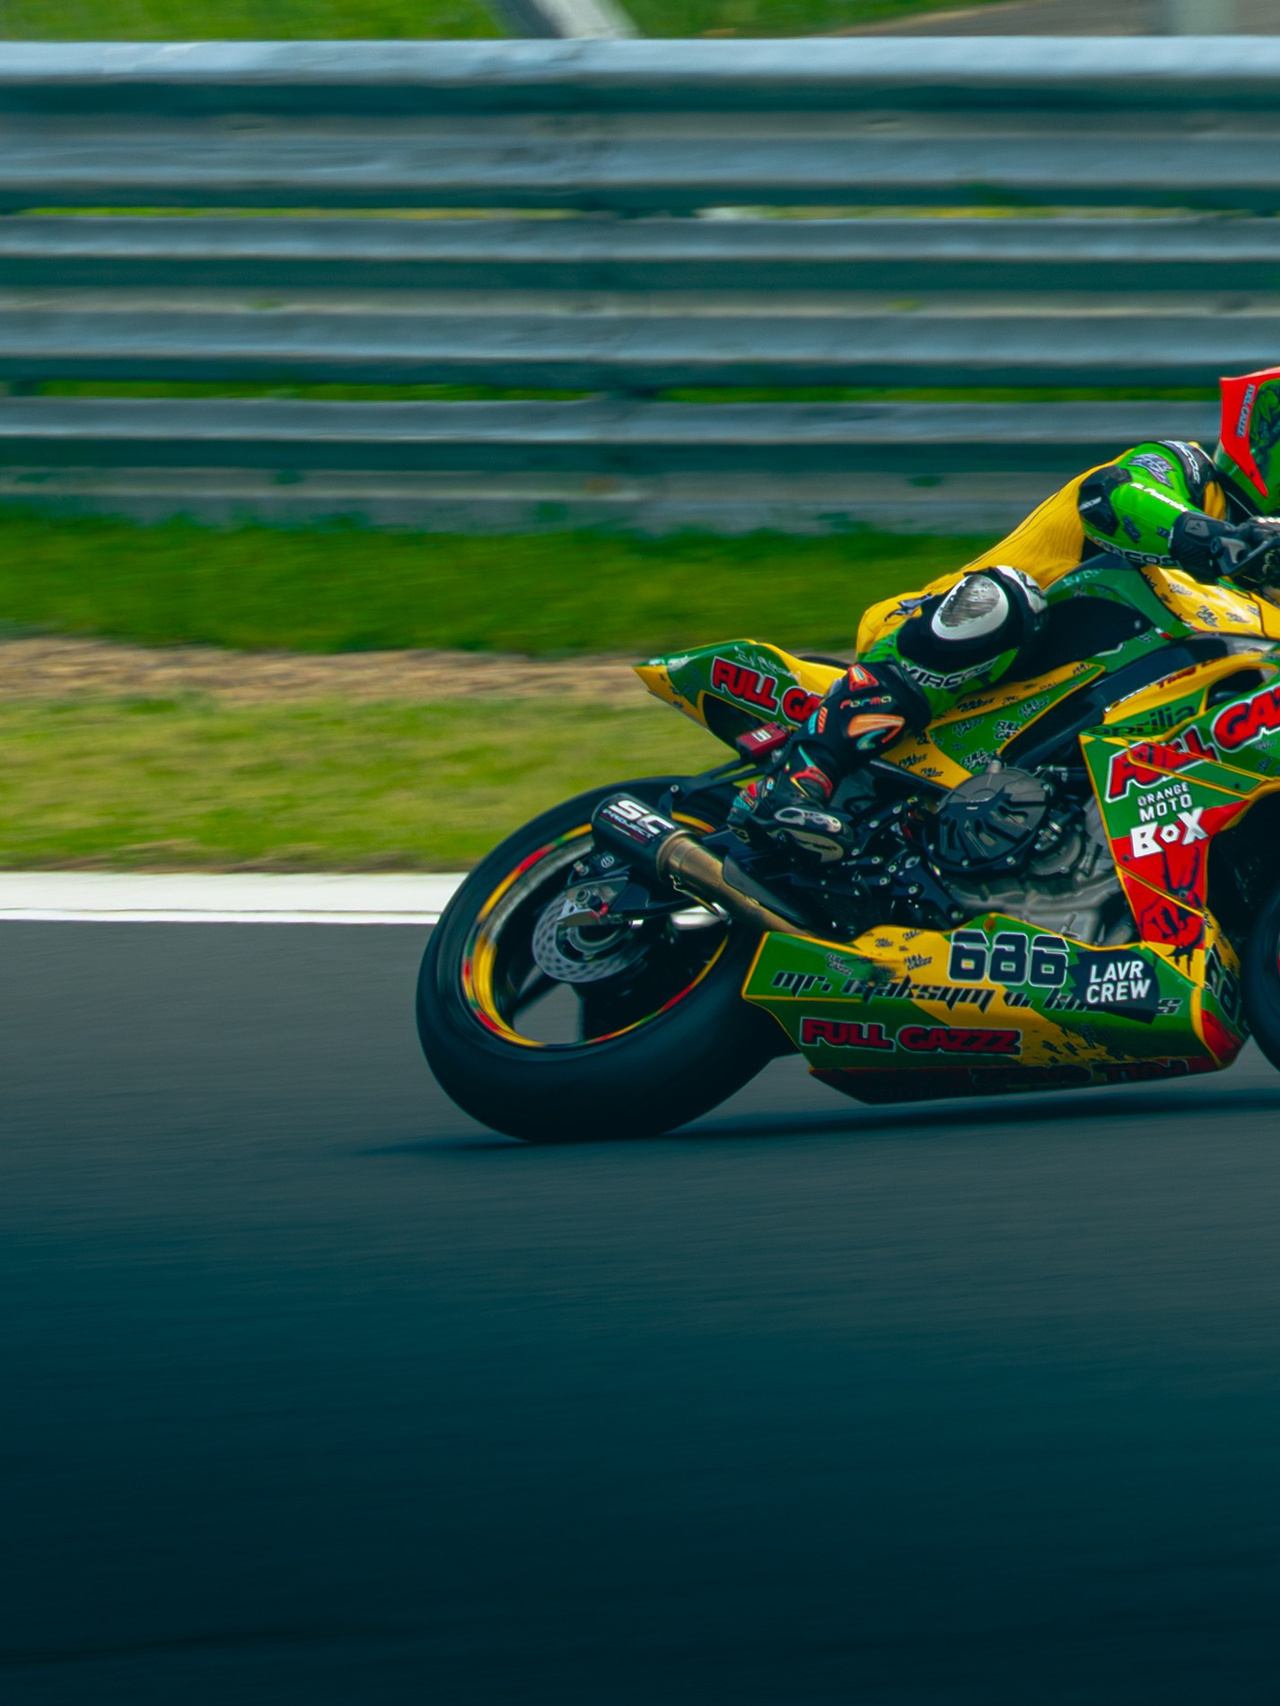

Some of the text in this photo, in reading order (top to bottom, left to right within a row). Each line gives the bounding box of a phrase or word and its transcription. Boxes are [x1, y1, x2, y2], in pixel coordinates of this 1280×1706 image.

[711, 655, 780, 715] FULL
[1106, 725, 1221, 803] FULL
[1137, 781, 1189, 807] ORANGE
[1139, 793, 1193, 822] MOTO
[947, 929, 1070, 988] 686
[1089, 960, 1145, 983] LAVR
[1086, 979, 1151, 1004] CREW
[800, 1016, 1023, 1055] FULL GAZZZ
